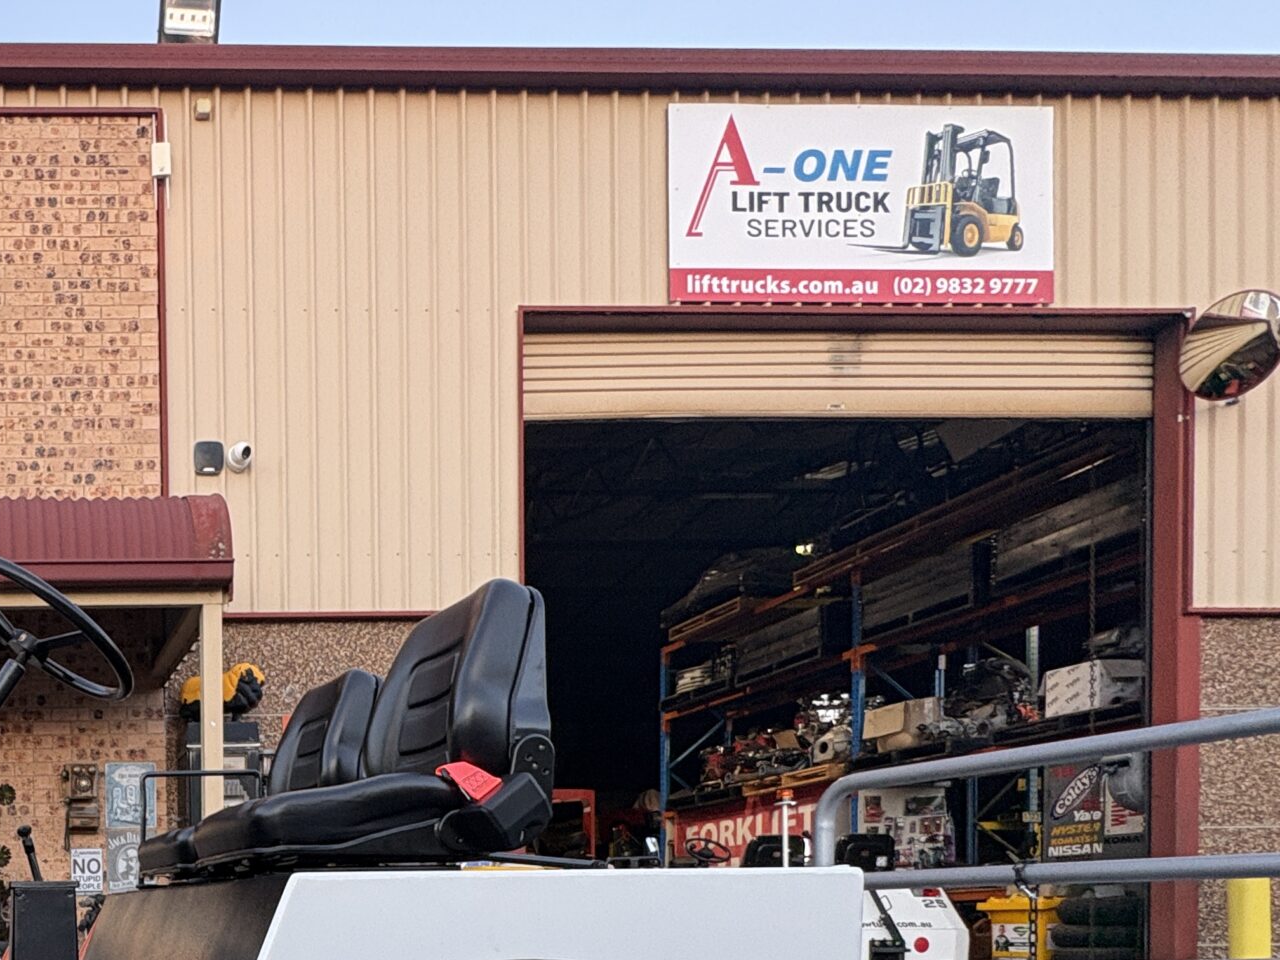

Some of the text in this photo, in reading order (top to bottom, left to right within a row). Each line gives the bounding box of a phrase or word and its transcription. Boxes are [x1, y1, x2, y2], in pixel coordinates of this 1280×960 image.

[731, 191, 890, 213] LIFT TRUCK
[747, 218, 876, 239] SERVICES
[686, 275, 1039, 296] lifttrucks.com.au (02) 9832 9777
[107, 834, 126, 849] JACK
[1048, 843, 1103, 857] NISSAN
[73, 858, 101, 875] NO
[922, 899, 947, 909] 25
